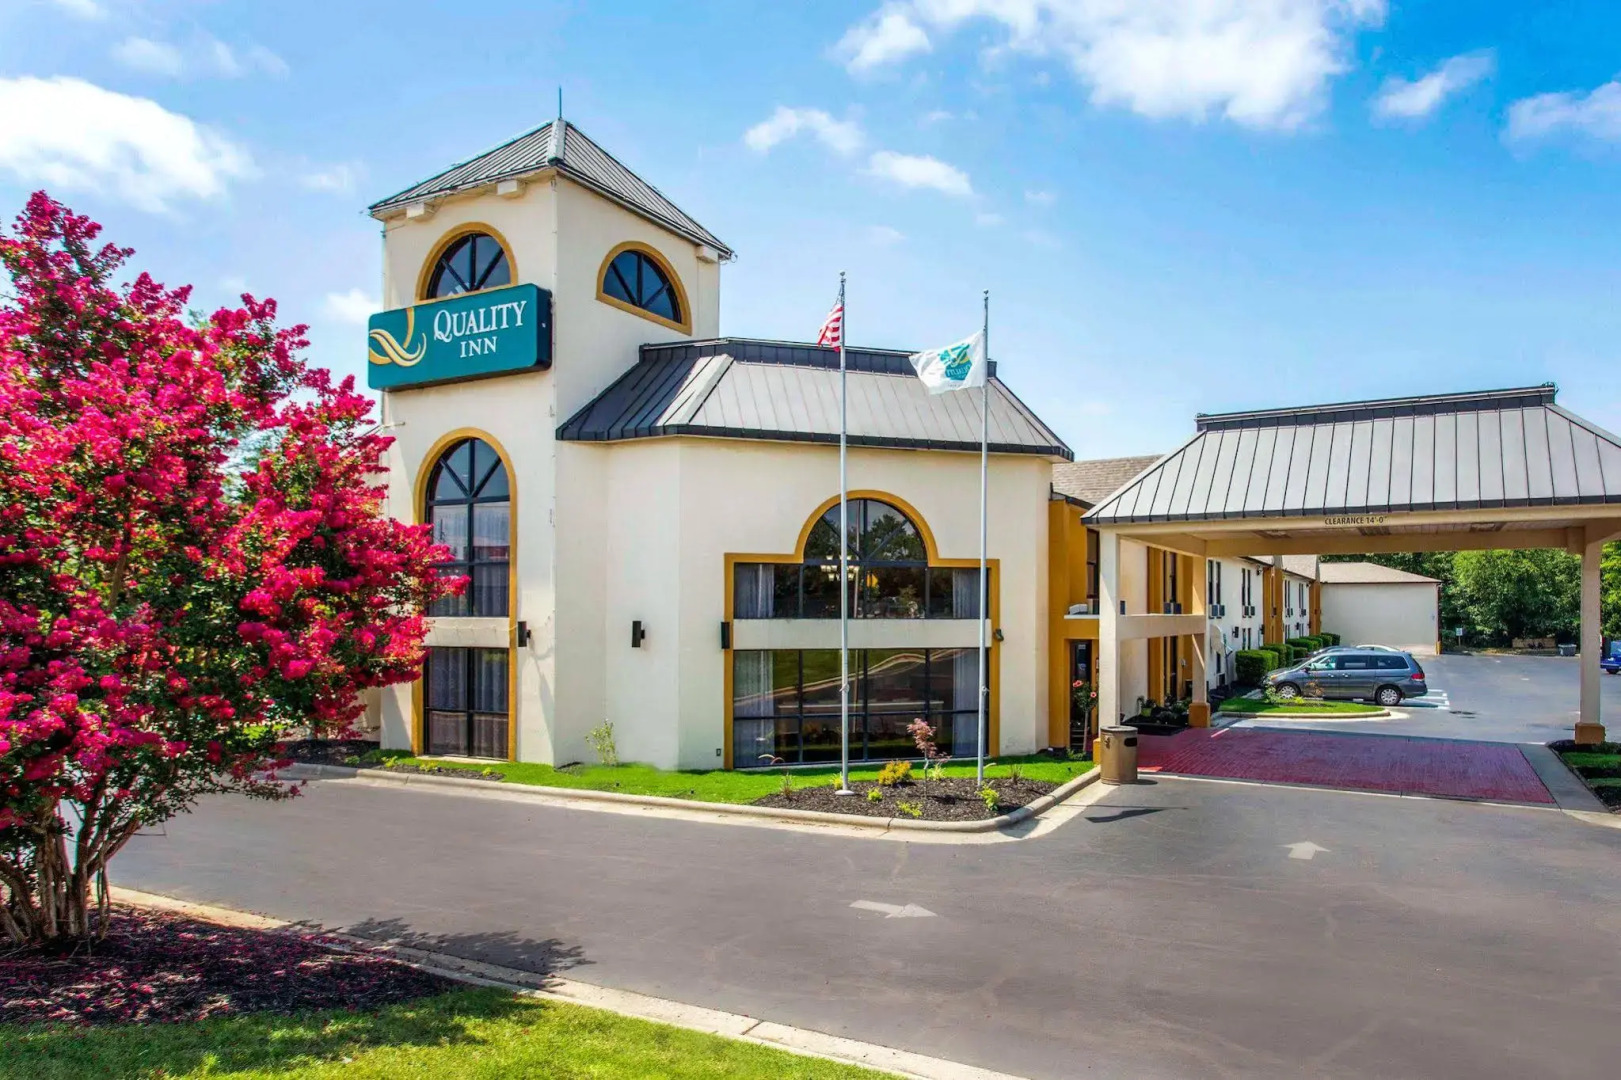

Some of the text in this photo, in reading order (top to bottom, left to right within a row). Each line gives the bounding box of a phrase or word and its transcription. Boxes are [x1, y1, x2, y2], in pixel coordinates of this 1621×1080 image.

[433, 301, 527, 342] QUALITY
[459, 336, 498, 358] INN
[1324, 516, 1364, 525] CLEARANCE
